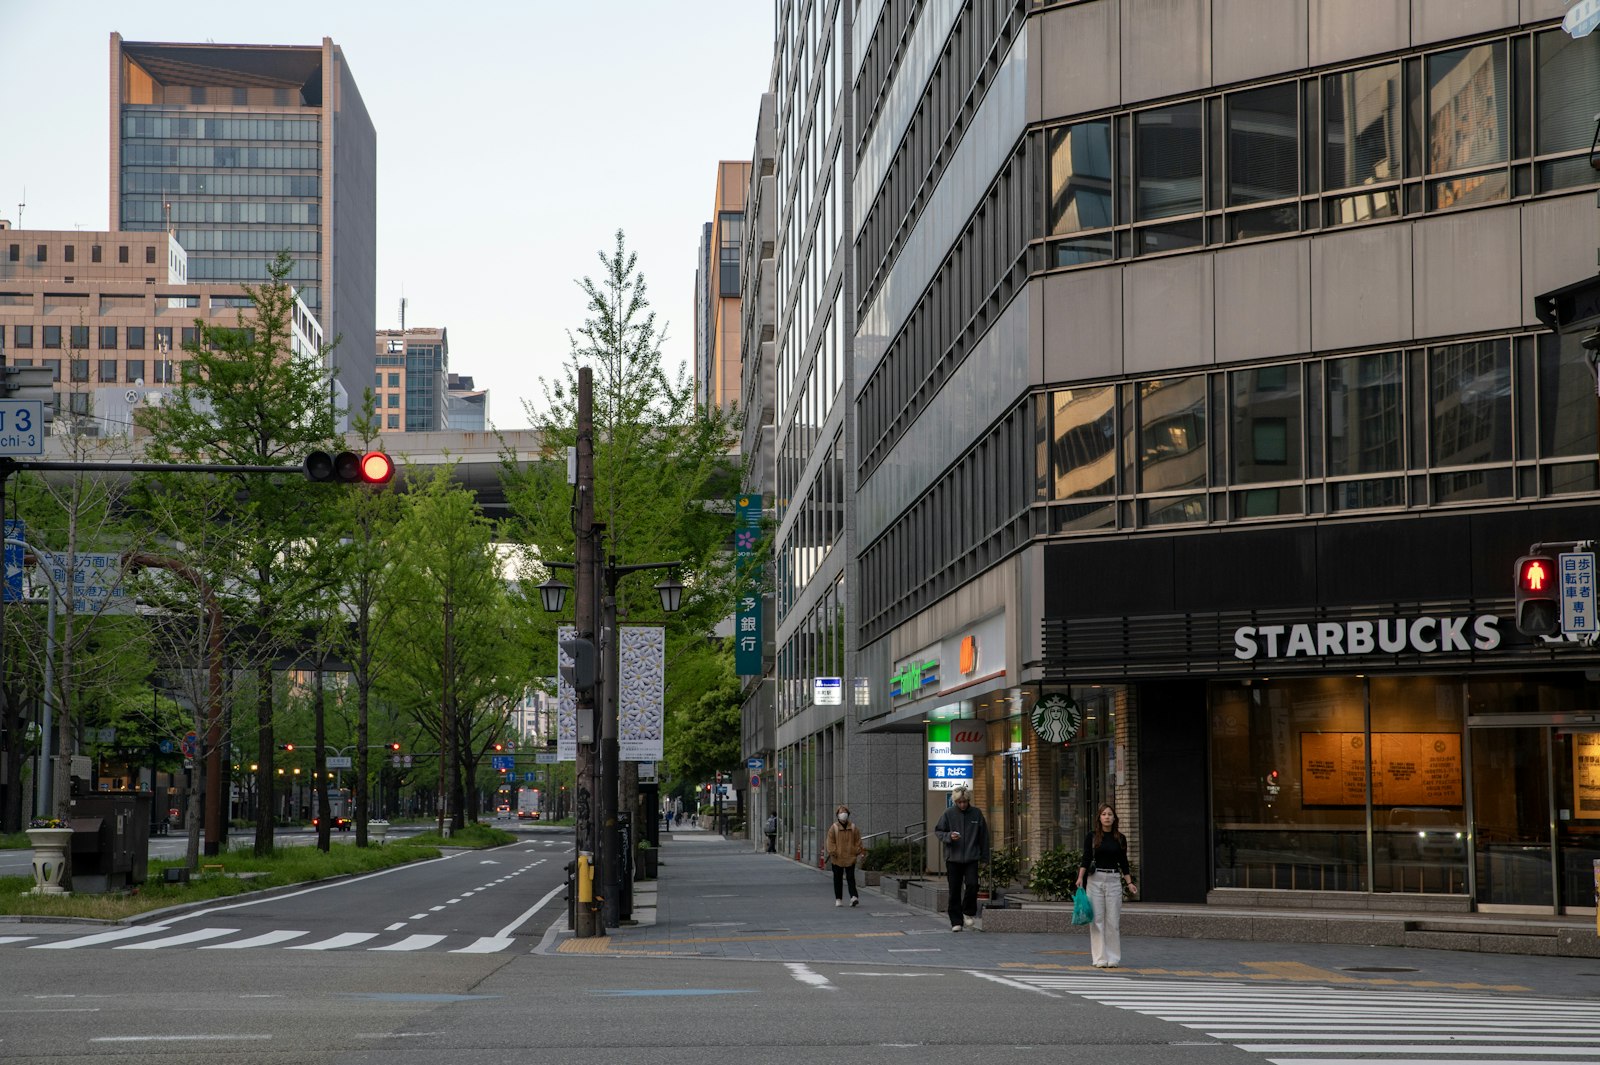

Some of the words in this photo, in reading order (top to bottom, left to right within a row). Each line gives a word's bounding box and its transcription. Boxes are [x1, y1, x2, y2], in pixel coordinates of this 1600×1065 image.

[1565, 559, 1577, 598] 自転車
[1578, 558, 1591, 598] 歩行者
[1572, 601, 1585, 628] 専用
[1234, 614, 1501, 660] STARBUCKS
[930, 746, 952, 755] Famil
[955, 731, 983, 743] au
[935, 766, 946, 777] 酒
[947, 767, 967, 777] たばこ
